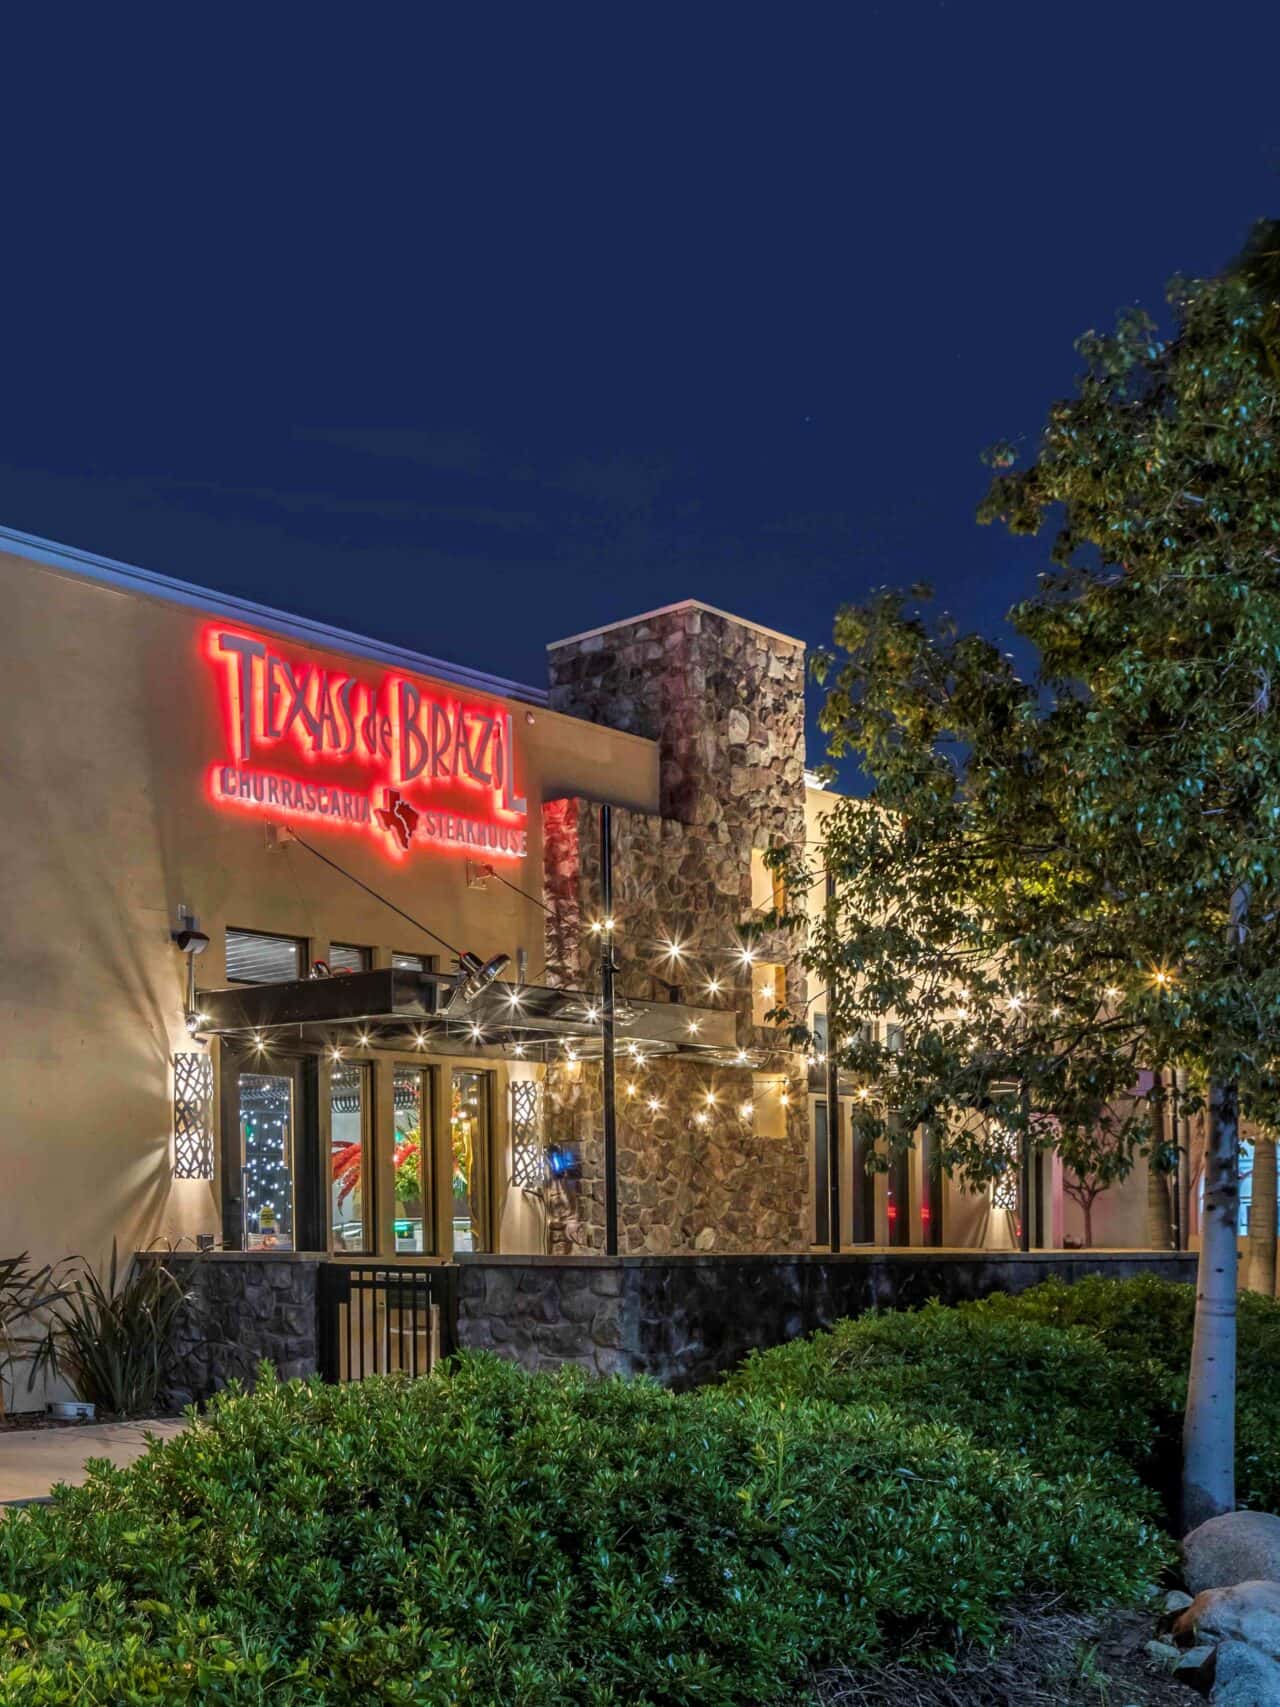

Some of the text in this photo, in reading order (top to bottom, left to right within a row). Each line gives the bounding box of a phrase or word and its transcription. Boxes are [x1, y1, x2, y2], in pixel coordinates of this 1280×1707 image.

[219, 632, 357, 761] TEXAS
[360, 690, 393, 758] de
[220, 767, 527, 856] CHURRASCARIA STEAKHOUSE
